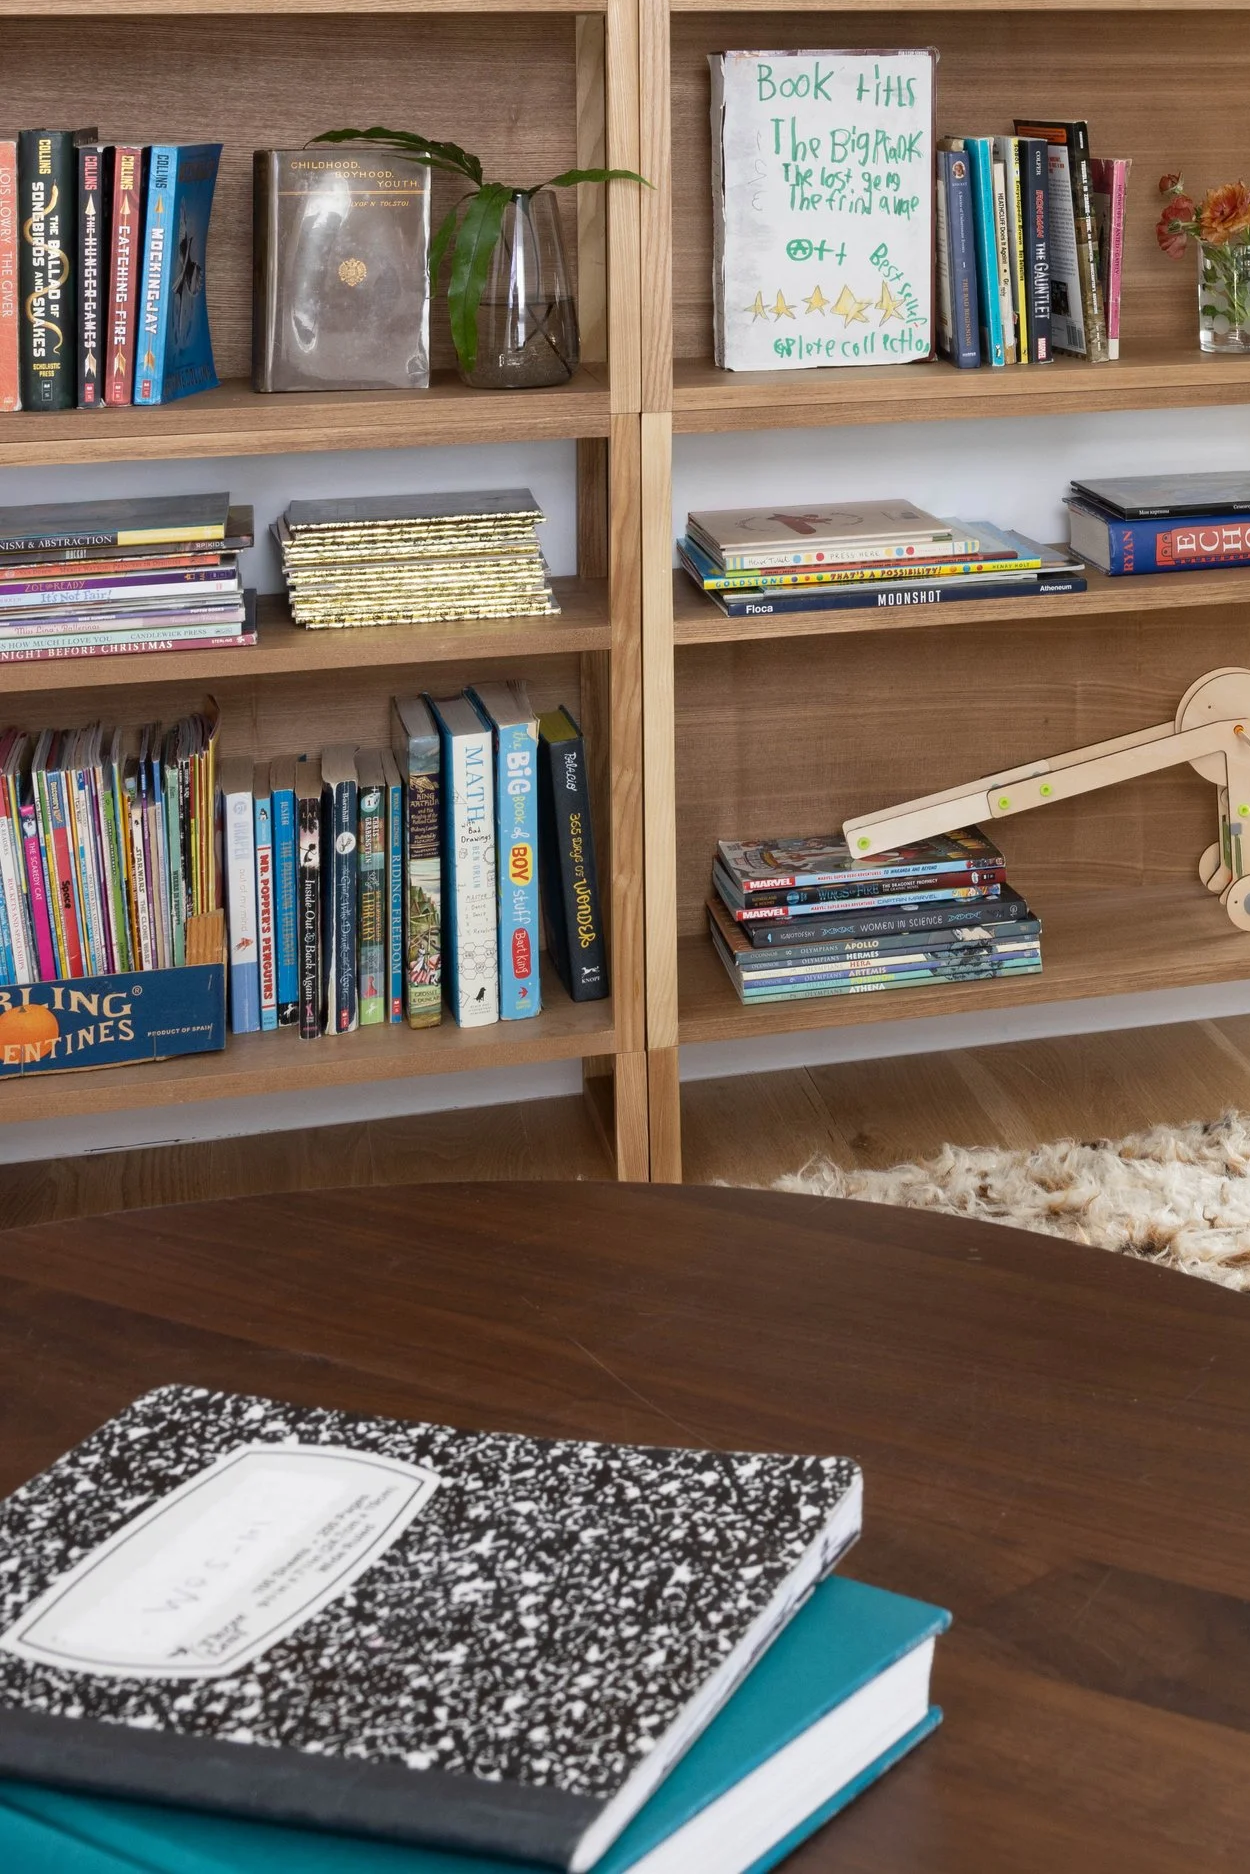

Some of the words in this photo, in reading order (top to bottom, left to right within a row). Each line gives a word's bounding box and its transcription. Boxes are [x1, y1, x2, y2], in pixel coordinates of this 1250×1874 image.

[770, 116, 821, 162] The
[830, 126, 870, 166] Big
[39, 139, 51, 175] COLLINS
[155, 154, 170, 189] COLLINS
[291, 161, 360, 169] CHILDHOOD.
[1, 167, 10, 197] LOIS
[84, 155, 97, 191] COLLINS
[121, 155, 134, 190] COLLINS
[377, 180, 420, 188] YOUTH.
[1, 200, 12, 243] LOWRY
[32, 182, 45, 266] SONGBIRDS
[49, 216, 58, 235] THE
[87, 215, 97, 233] THE
[2, 252, 12, 278] THE
[115, 225, 131, 303] CATCHING
[869, 242, 904, 282] Best
[1035, 242, 1045, 261] THE
[34, 271, 43, 293] AND
[48, 239, 61, 300] BALLAD
[84, 237, 97, 298] HUNGER
[144, 228, 164, 334] MOCKINGJAY
[2, 281, 14, 319] GIVER
[1034, 262, 1050, 320] GAUNTLET
[51, 305, 60, 318] OF
[84, 302, 97, 348] GAMES
[33, 297, 46, 357] SNAKES
[114, 310, 126, 346] FIRE
[38, 535, 112, 548] ABSTRACTION
[1122, 530, 1135, 572] RYAN
[716, 577, 784, 588] GOLDSTONE
[830, 571, 864, 581] THAT'S
[881, 566, 942, 576] POSSIBILITY!
[40, 593, 57, 604] It's
[60, 591, 80, 602] Not
[83, 589, 112, 602] Fair!
[746, 603, 774, 614] Floca
[878, 590, 941, 607] MOONSHOT
[1040, 584, 1072, 592] Atheneum
[1, 649, 43, 660] NIGHT
[48, 646, 96, 657] BEFORE
[101, 640, 173, 654] CHRISTMAS
[9, 639, 30, 648] HOW
[33, 638, 59, 647] MUCH
[68, 637, 92, 645] LOVE
[94, 635, 113, 643] YOU
[131, 631, 181, 640] CANDLEWICK
[464, 746, 485, 822] MATH
[570, 813, 581, 835] 365
[259, 854, 269, 877] MR.
[393, 854, 401, 894] RIDING
[511, 846, 529, 881] BOY
[62, 880, 71, 910] Space
[305, 880, 316, 908] Inside
[749, 878, 792, 889] MARVEL
[260, 878, 272, 935] POPPER'S
[305, 910, 316, 929] Out
[512, 890, 531, 925] stuff
[573, 878, 596, 948] WONDER
[742, 908, 785, 919] MARVEL
[392, 900, 401, 974] FREEDOM
[859, 921, 895, 933] WOMEN
[897, 919, 906, 929] IN
[909, 915, 943, 927] SCIENCE
[305, 945, 316, 969] Back
[844, 940, 879, 950] APOLLO
[846, 951, 879, 960] HERMES
[261, 941, 273, 1000] PENGUINS
[850, 960, 872, 968] HERA
[302, 972, 316, 1000] Again
[848, 983, 886, 993] ATHENA
[147, 1028, 180, 1037] PRODUCT
